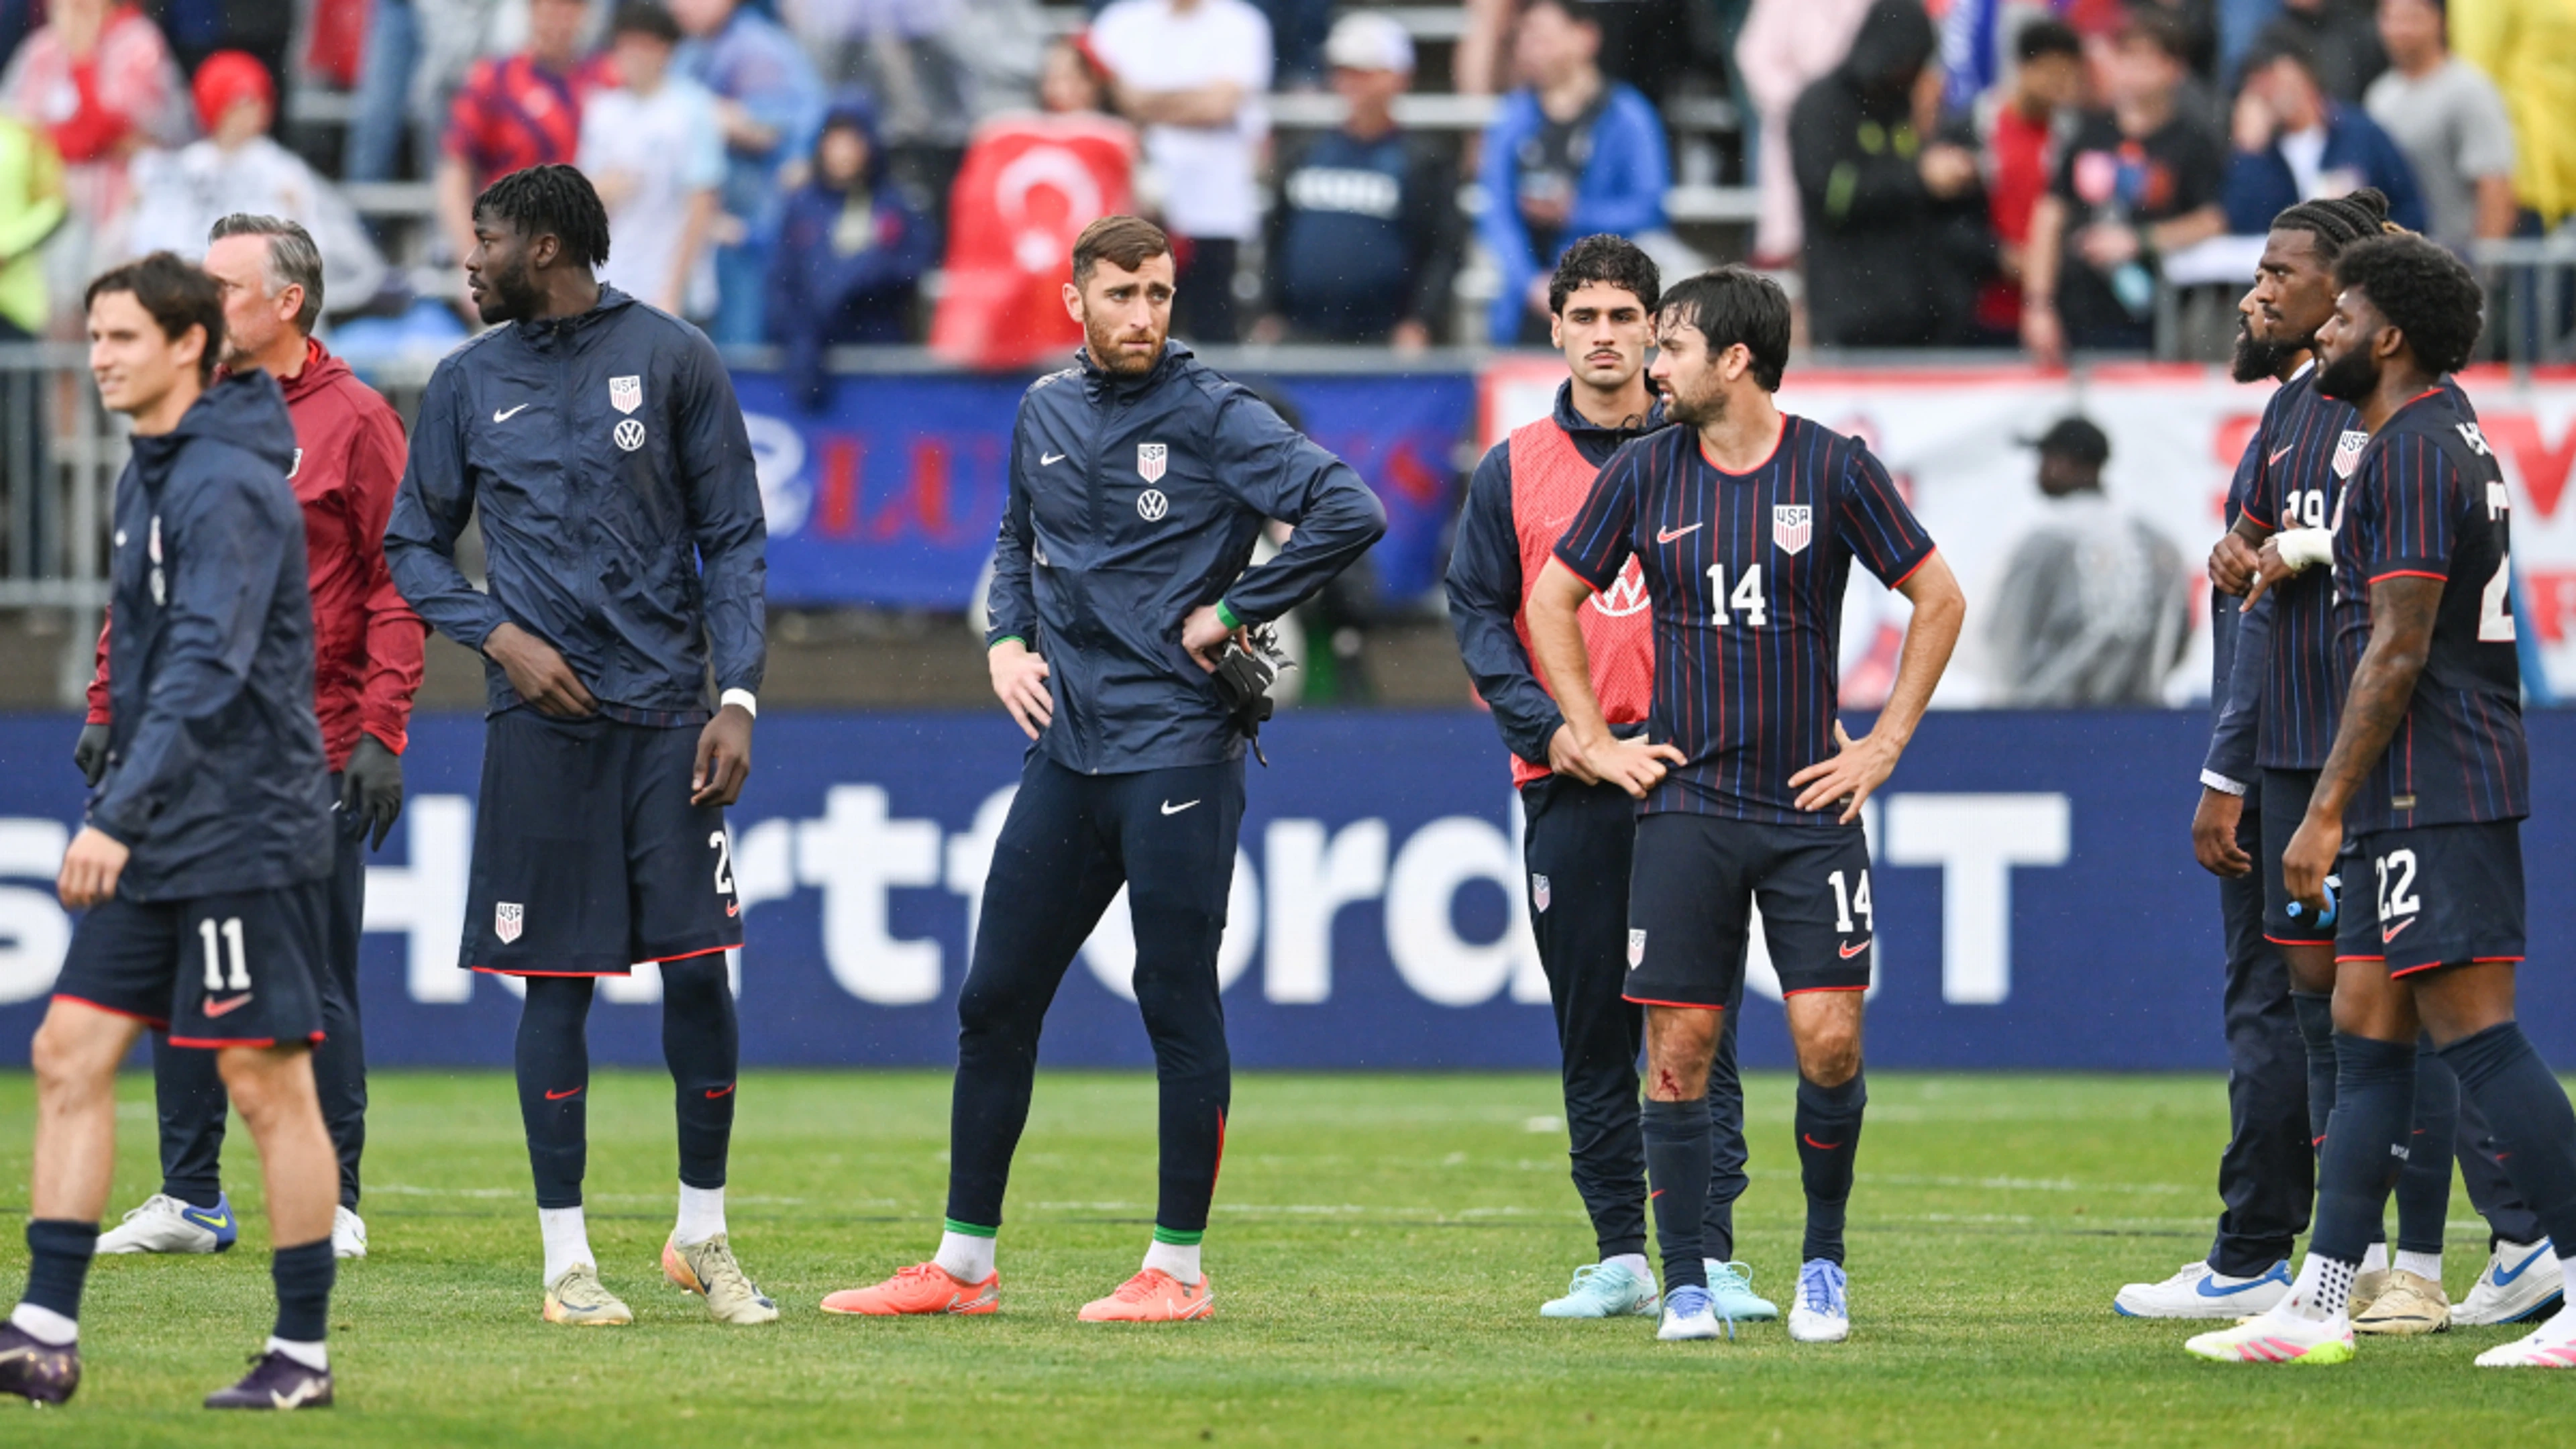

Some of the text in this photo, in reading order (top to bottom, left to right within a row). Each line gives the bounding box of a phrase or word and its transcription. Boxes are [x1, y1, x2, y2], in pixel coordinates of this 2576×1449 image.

[1776, 508, 1809, 527] USA
[2286, 489, 2324, 528] 19
[1706, 564, 1767, 626] 14
[1744, 792, 2072, 1006] T
[1828, 869, 1873, 932] 14
[2375, 848, 2420, 922] 22
[198, 916, 252, 990] 11
